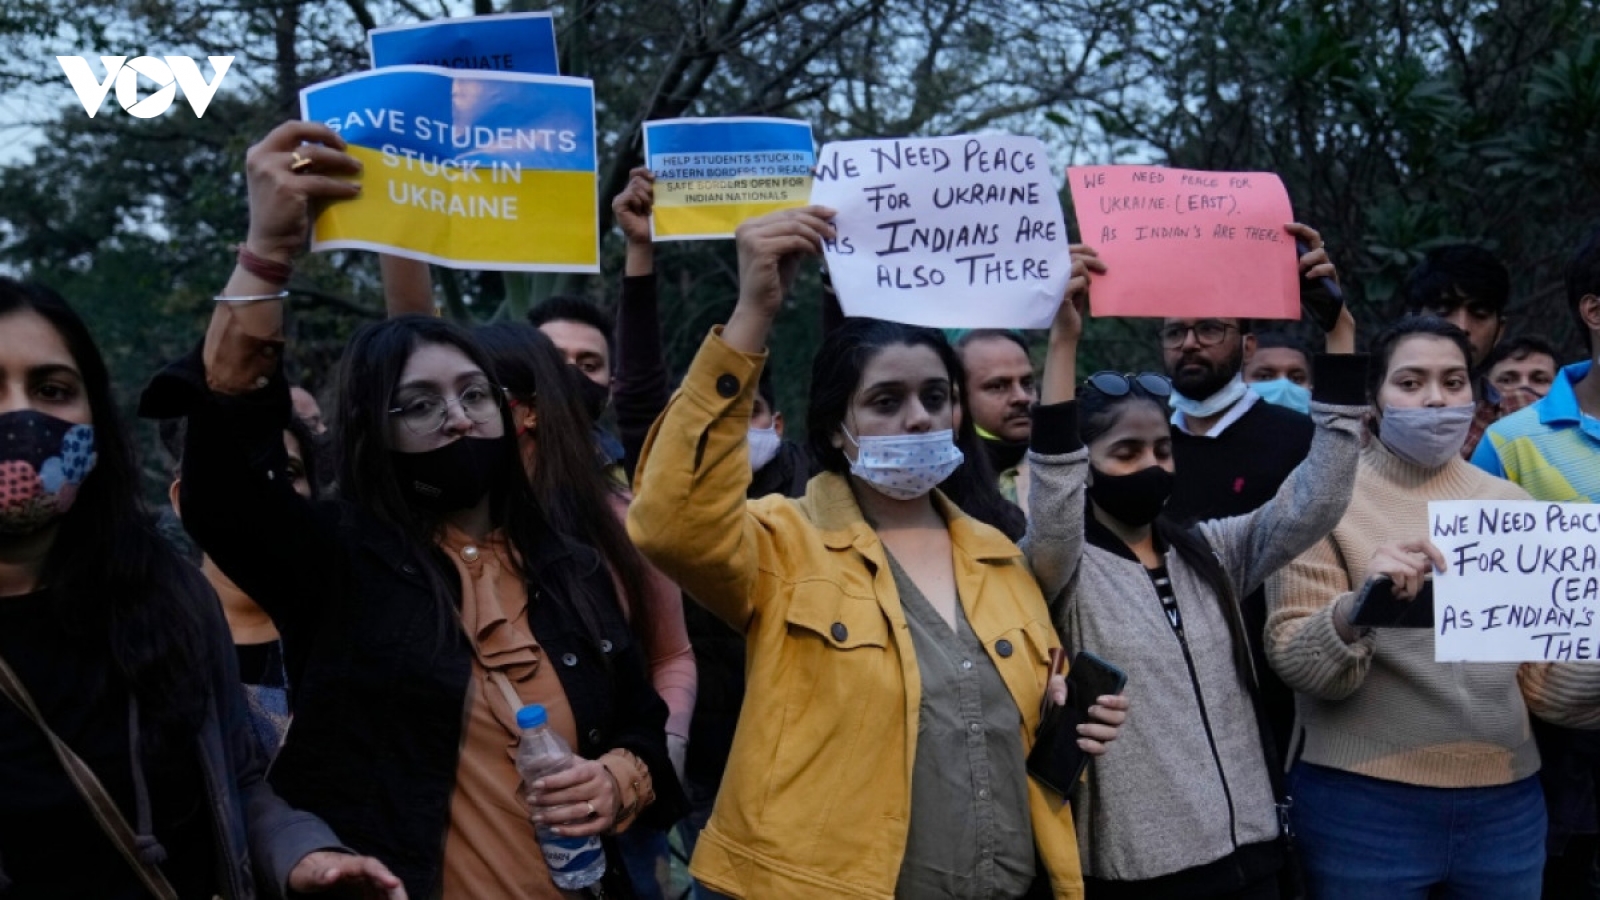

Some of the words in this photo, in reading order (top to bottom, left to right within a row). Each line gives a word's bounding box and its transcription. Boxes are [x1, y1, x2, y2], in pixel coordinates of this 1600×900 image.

[323, 108, 405, 135] SAVE
[415, 116, 577, 152] STUDENTS
[382, 144, 481, 183] STUCK
[492, 161, 522, 185] IN
[663, 155, 690, 166] HELP
[694, 154, 751, 165] STUDENTS
[753, 153, 789, 163] STUCK
[792, 153, 804, 161] IN
[706, 167, 758, 177] BORDERS
[761, 166, 776, 175] TO
[814, 152, 860, 181] WE
[871, 141, 950, 173] NEED
[964, 139, 1037, 174] PEACE
[666, 181, 694, 192] SAFE
[751, 178, 780, 189] OPEN
[782, 177, 805, 188] FOR
[1084, 172, 1106, 188] WE
[1132, 171, 1165, 184] NEED
[1181, 174, 1219, 188] PEACE
[1229, 177, 1252, 189] FOR
[388, 180, 518, 220] UKRAINE
[685, 192, 724, 203] INDIAN
[725, 190, 789, 201] NATIONALS
[863, 184, 911, 212] FOR
[932, 183, 1040, 209] UKRAINE
[875, 219, 1000, 256] INDIANS
[1015, 215, 1057, 244] ARE
[1101, 225, 1117, 243] AS
[1135, 225, 1201, 241] INDIAN'S
[1213, 223, 1237, 240] ARE
[876, 264, 945, 289] ALSO
[955, 253, 1051, 285] THERE
[1434, 513, 1469, 537] WE
[1478, 508, 1536, 535] NEED
[1546, 504, 1600, 533] PEAC
[1452, 541, 1509, 576] FOR
[1517, 543, 1600, 575] UKRA
[1440, 604, 1474, 636] AS
[1481, 604, 1595, 632] INDIAN'S
[1531, 632, 1600, 663] THE
